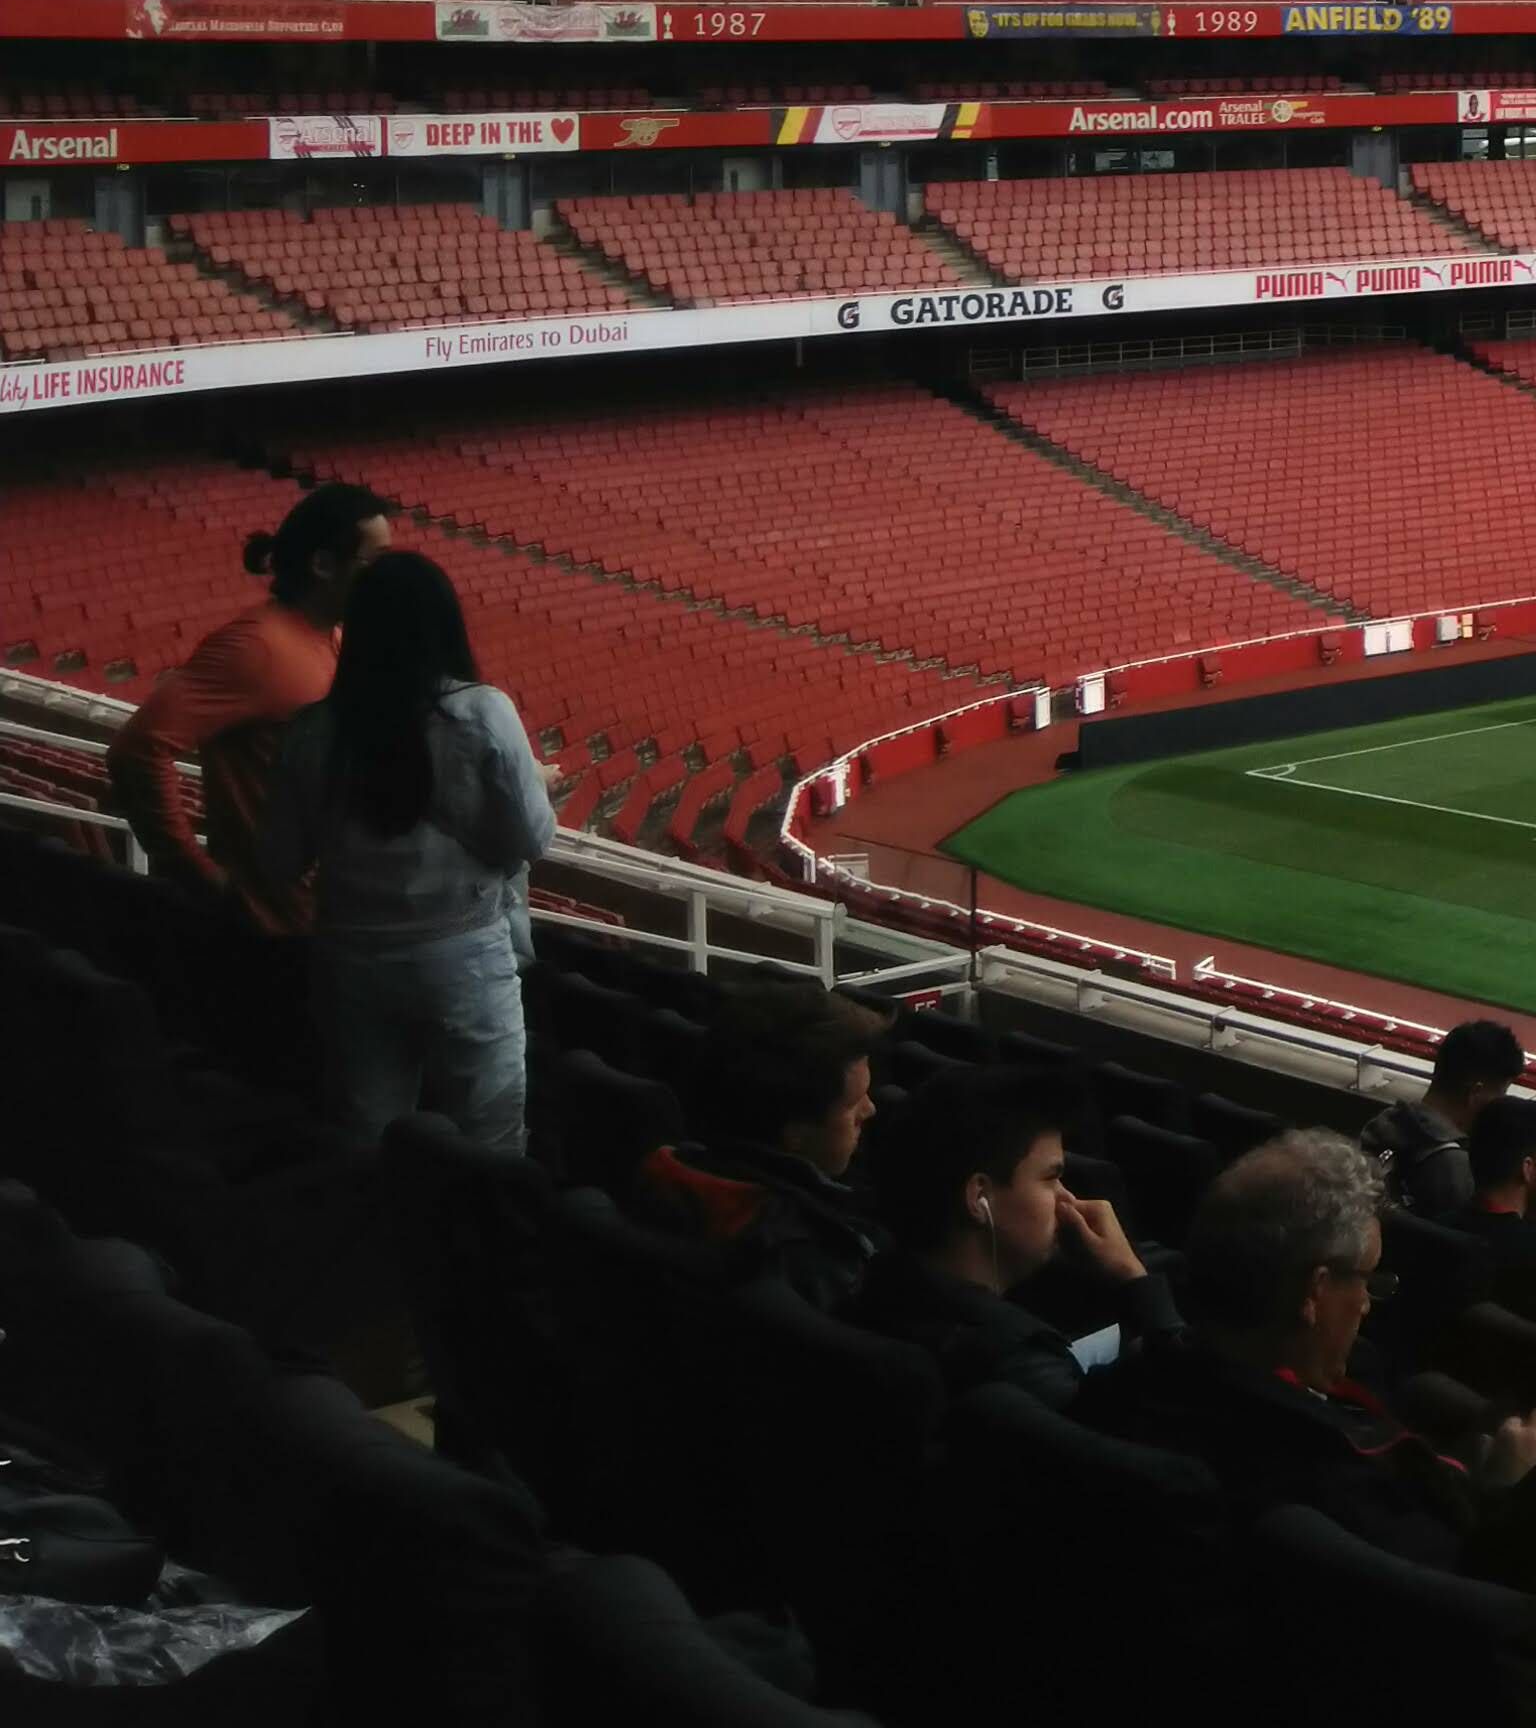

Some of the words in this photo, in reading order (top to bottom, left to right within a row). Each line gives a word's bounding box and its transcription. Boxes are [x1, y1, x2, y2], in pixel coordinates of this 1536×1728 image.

[694, 12, 767, 36] 1987
[1195, 11, 1258, 33] 1989
[1286, 6, 1403, 31] ANFIELD
[1411, 6, 1451, 30] '89
[1069, 106, 1213, 132] Arsenal.com
[1219, 100, 1263, 113] Arsenal
[1219, 112, 1266, 125] TRALEE
[9, 128, 118, 160] Arsenal
[426, 123, 475, 147] DEEP
[480, 122, 501, 145] IN
[507, 121, 544, 143] THE
[1256, 272, 1325, 299] PUMA
[1356, 267, 1421, 293] PUMA
[1450, 260, 1513, 286] PUMA
[837, 301, 860, 330] G
[890, 288, 1073, 325] GATORADE
[1102, 284, 1124, 310] G
[425, 337, 453, 362] Fly
[459, 332, 534, 355] Emirates
[541, 330, 561, 347] to
[569, 321, 629, 345] Dubai
[33, 371, 71, 400] LIFE
[77, 359, 185, 396] INSURANCE
